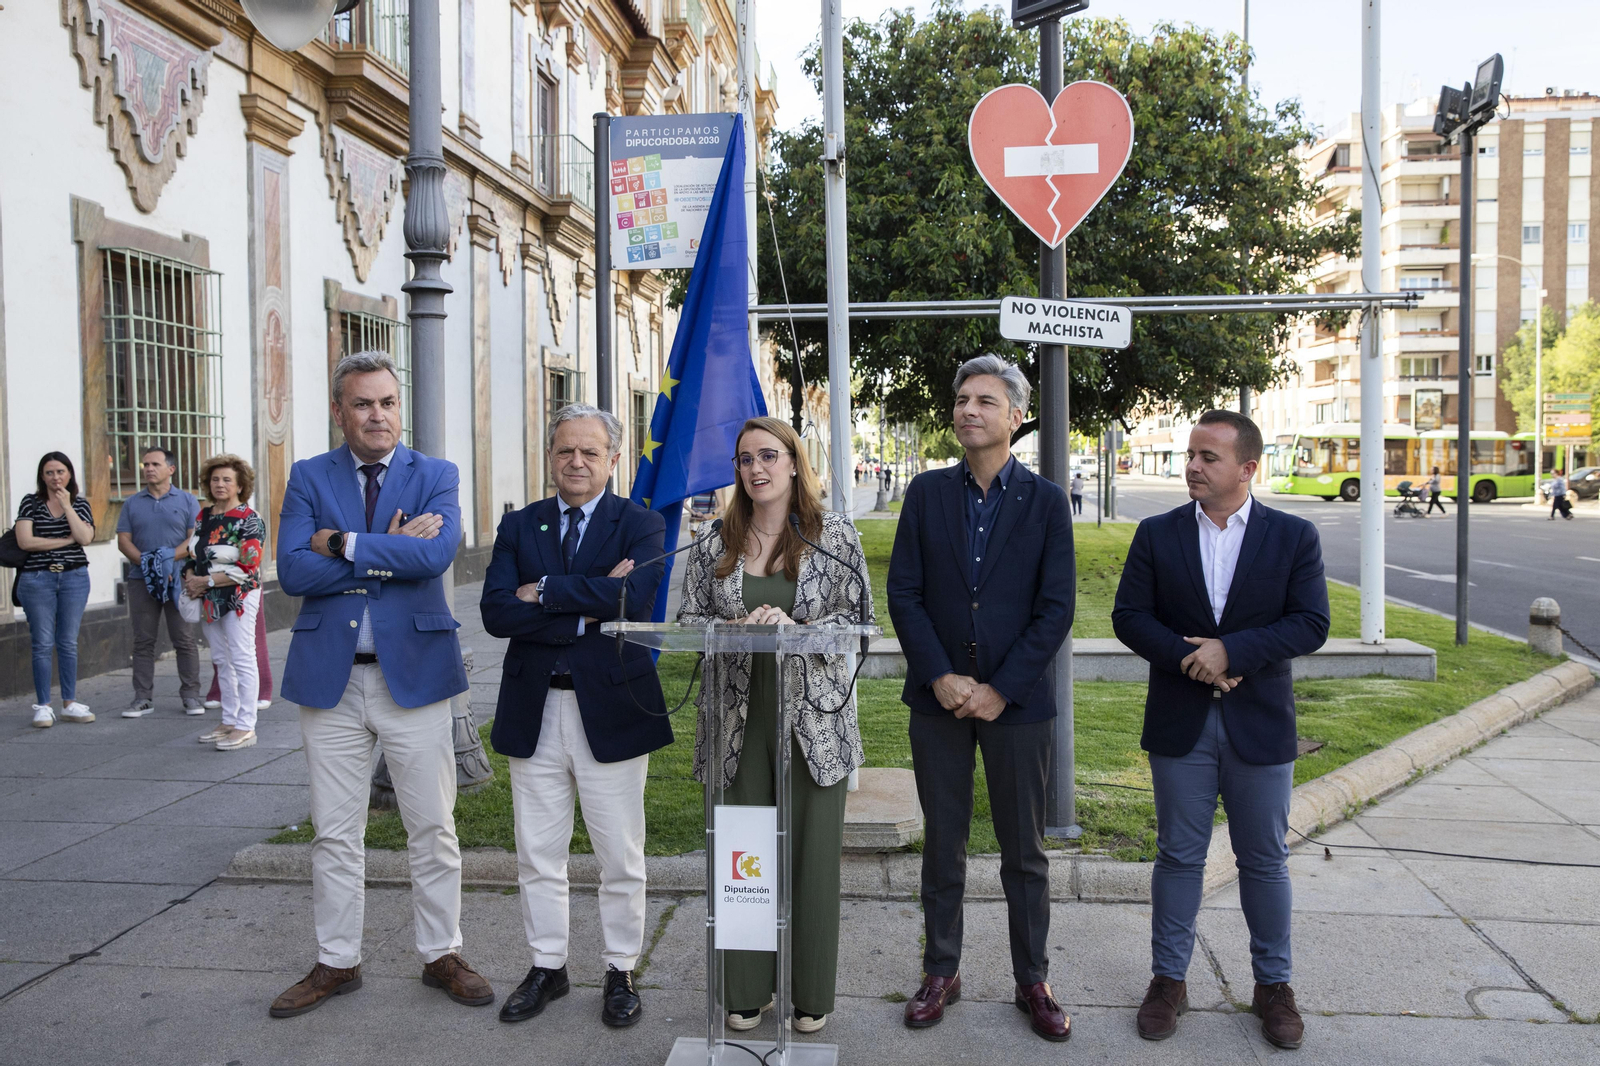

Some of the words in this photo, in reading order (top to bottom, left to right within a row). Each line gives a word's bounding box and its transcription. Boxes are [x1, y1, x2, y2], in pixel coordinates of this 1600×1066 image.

[626, 126, 719, 136] PARTICIPAMOS
[626, 137, 696, 147] DIPUCORDOBA
[698, 136, 720, 145] 2030
[1011, 301, 1036, 315] NO
[1041, 304, 1121, 323] VIOLENCIA
[1027, 321, 1104, 340] MACHISTA
[724, 885, 770, 894] Diputación
[724, 895, 735, 903] de
[736, 895, 770, 904] Córdoba
